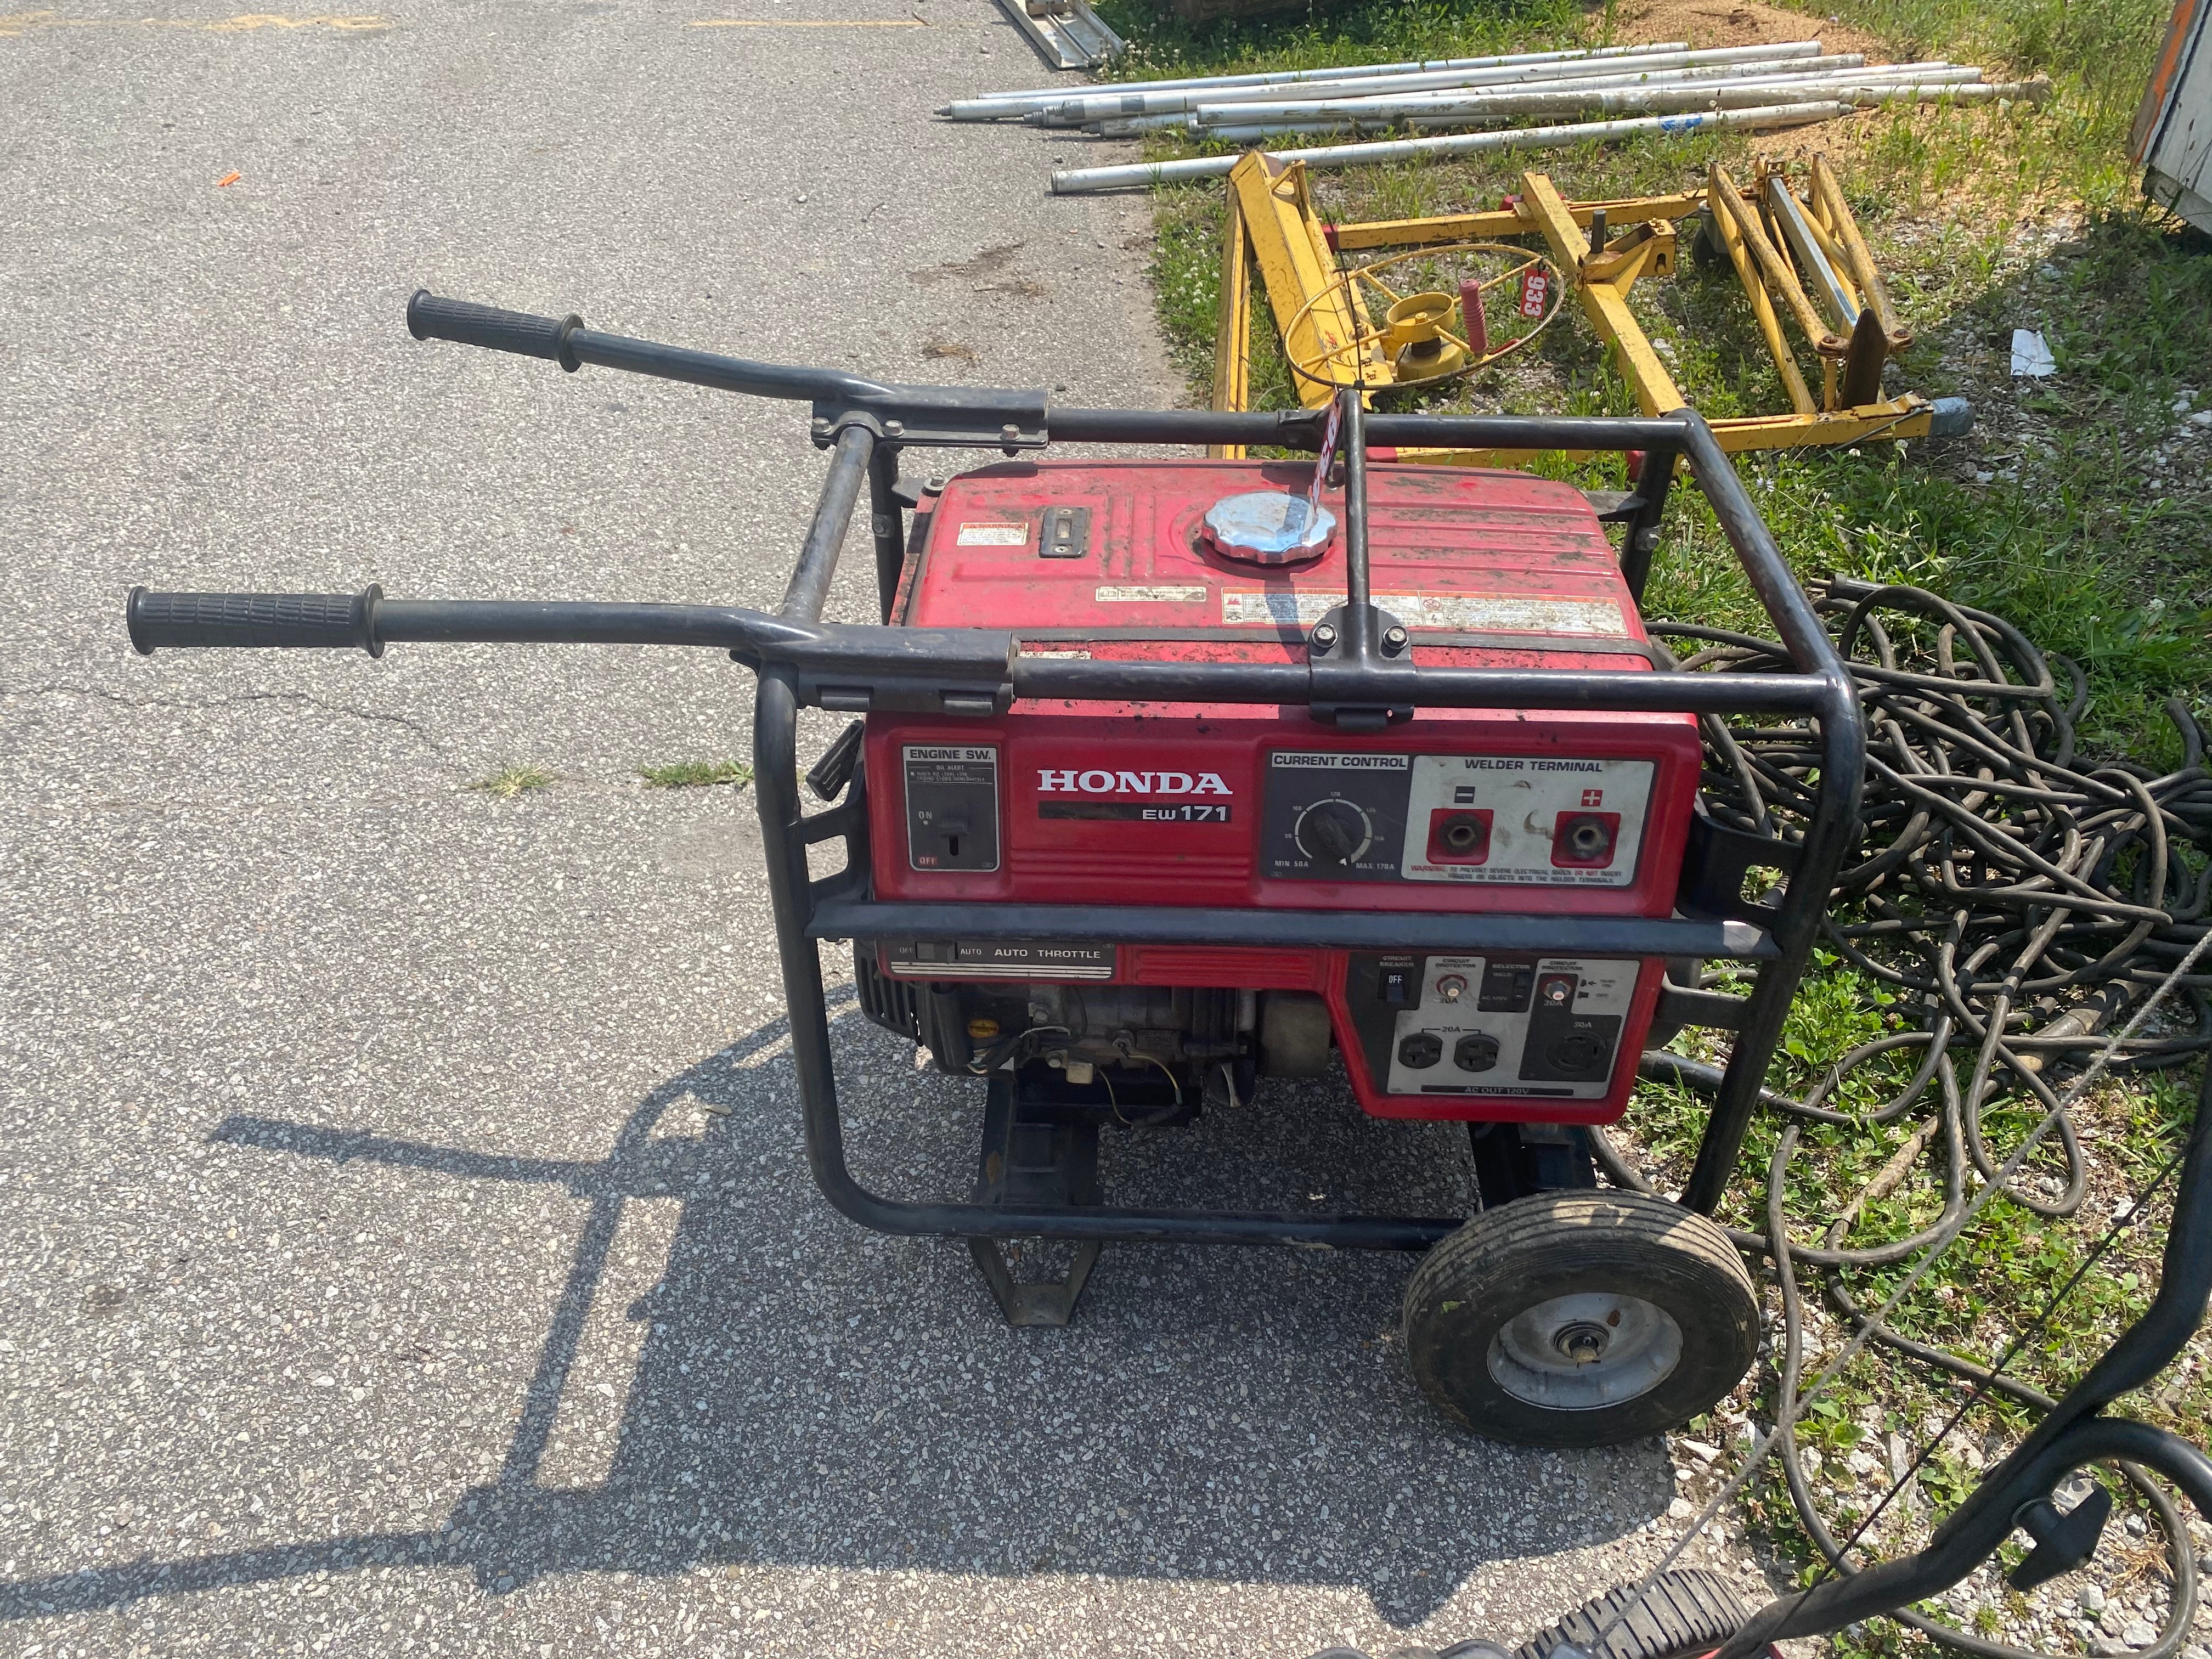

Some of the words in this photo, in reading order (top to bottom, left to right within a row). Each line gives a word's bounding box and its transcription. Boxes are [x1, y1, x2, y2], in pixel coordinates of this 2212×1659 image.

[1524, 275, 1545, 316] 933
[910, 749, 960, 759] ENGINE
[966, 750, 991, 760] SW.
[1273, 755, 1338, 766] CURRENT
[1341, 757, 1406, 768] CONTROL
[1465, 759, 1524, 770] WELDER
[1530, 760, 1602, 772] TERMINAL
[1037, 769, 1233, 794] HONDA
[918, 811, 933, 819] ON
[994, 949, 1028, 957] AUTO
[1037, 949, 1101, 958] THROTTLE
[1388, 975, 1403, 984] OFF
